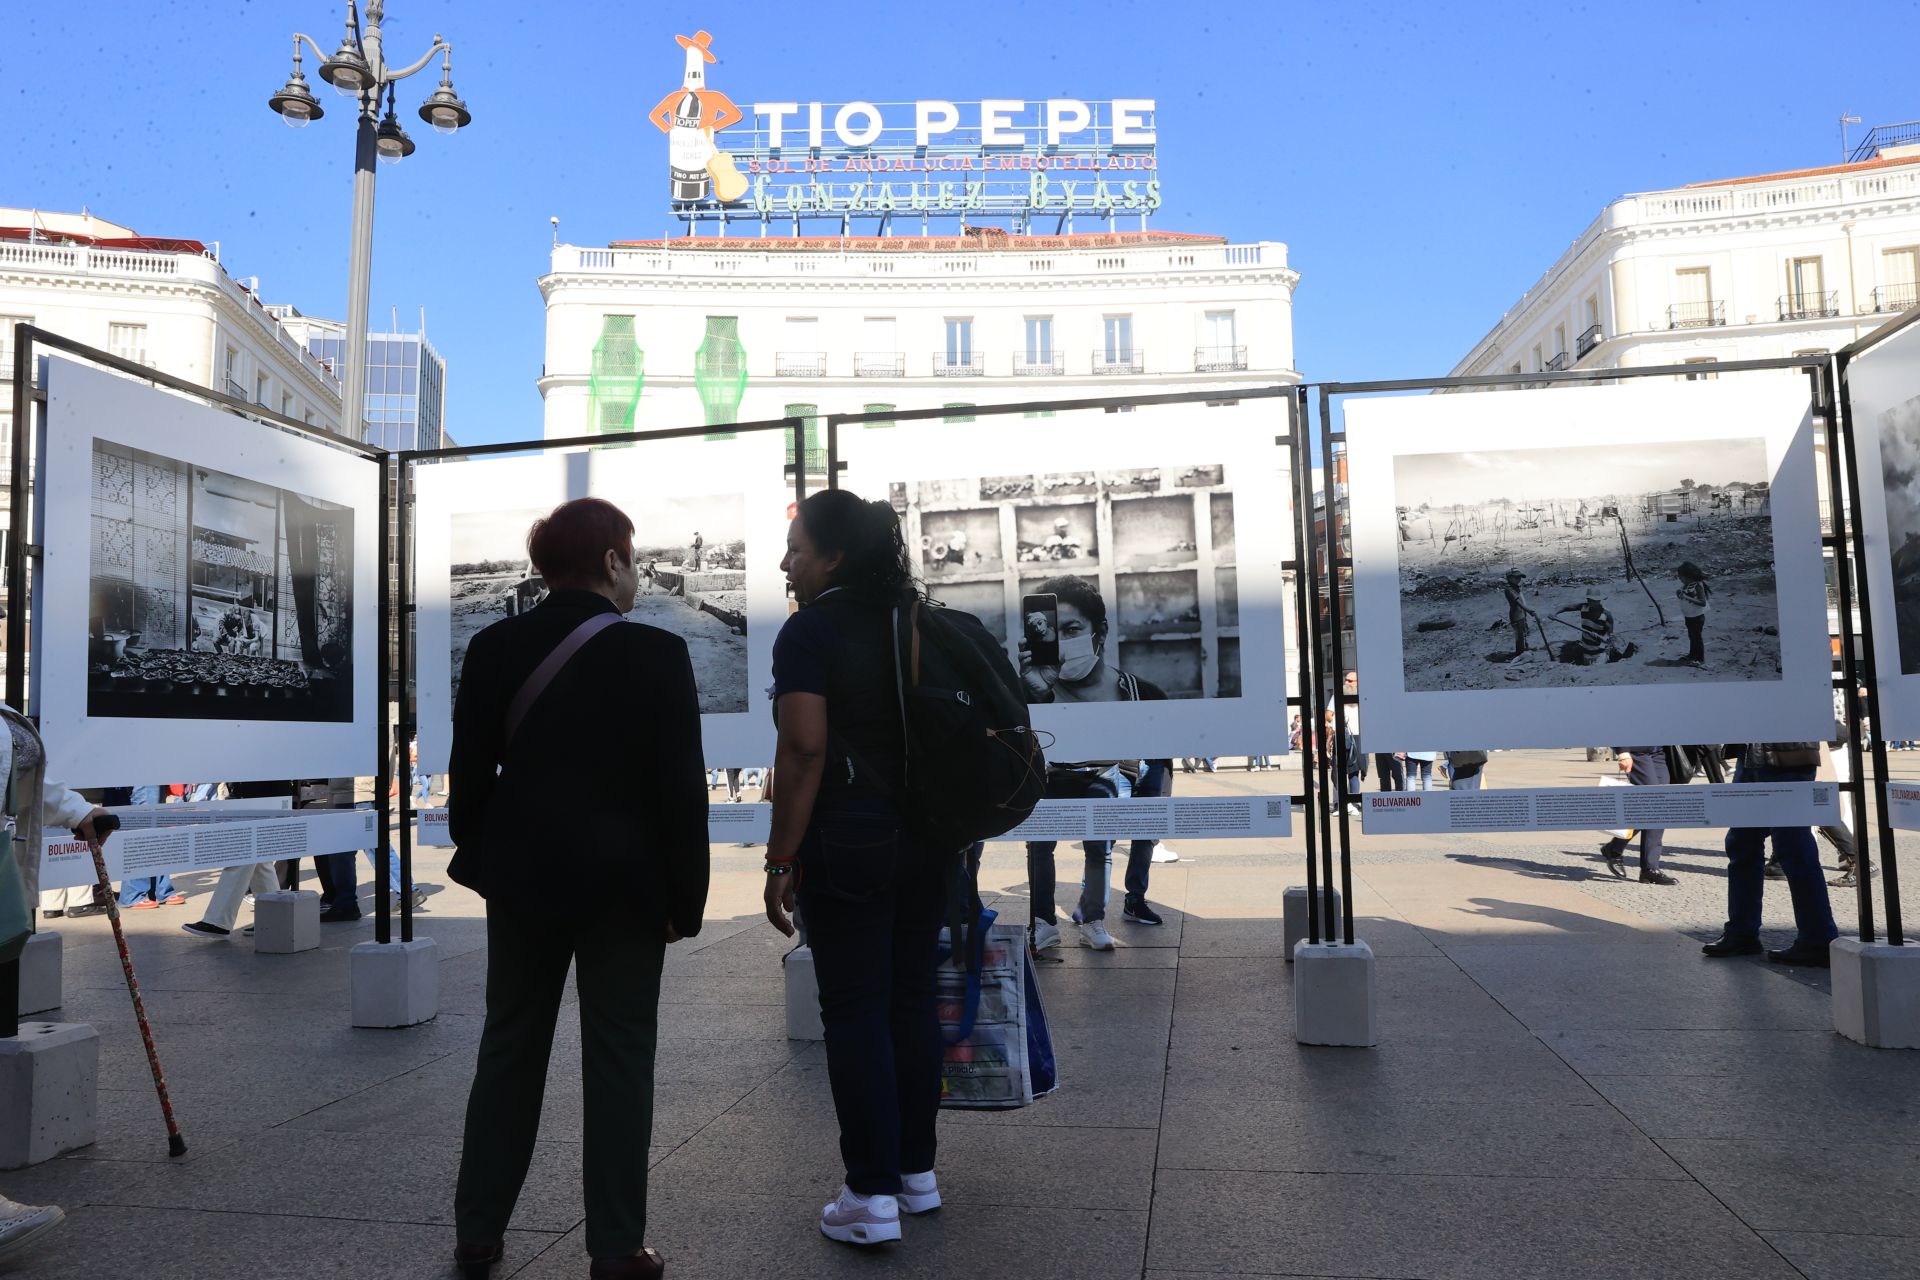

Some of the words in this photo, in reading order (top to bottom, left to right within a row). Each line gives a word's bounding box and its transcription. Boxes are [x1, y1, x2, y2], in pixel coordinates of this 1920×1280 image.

[754, 101, 883, 148] TIO
[916, 99, 1157, 146] PEPE
[749, 159, 796, 174] SOL
[804, 158, 833, 173] DE
[1029, 171, 1162, 210] BYASS
[1372, 797, 1422, 808] BOLIVARIANO
